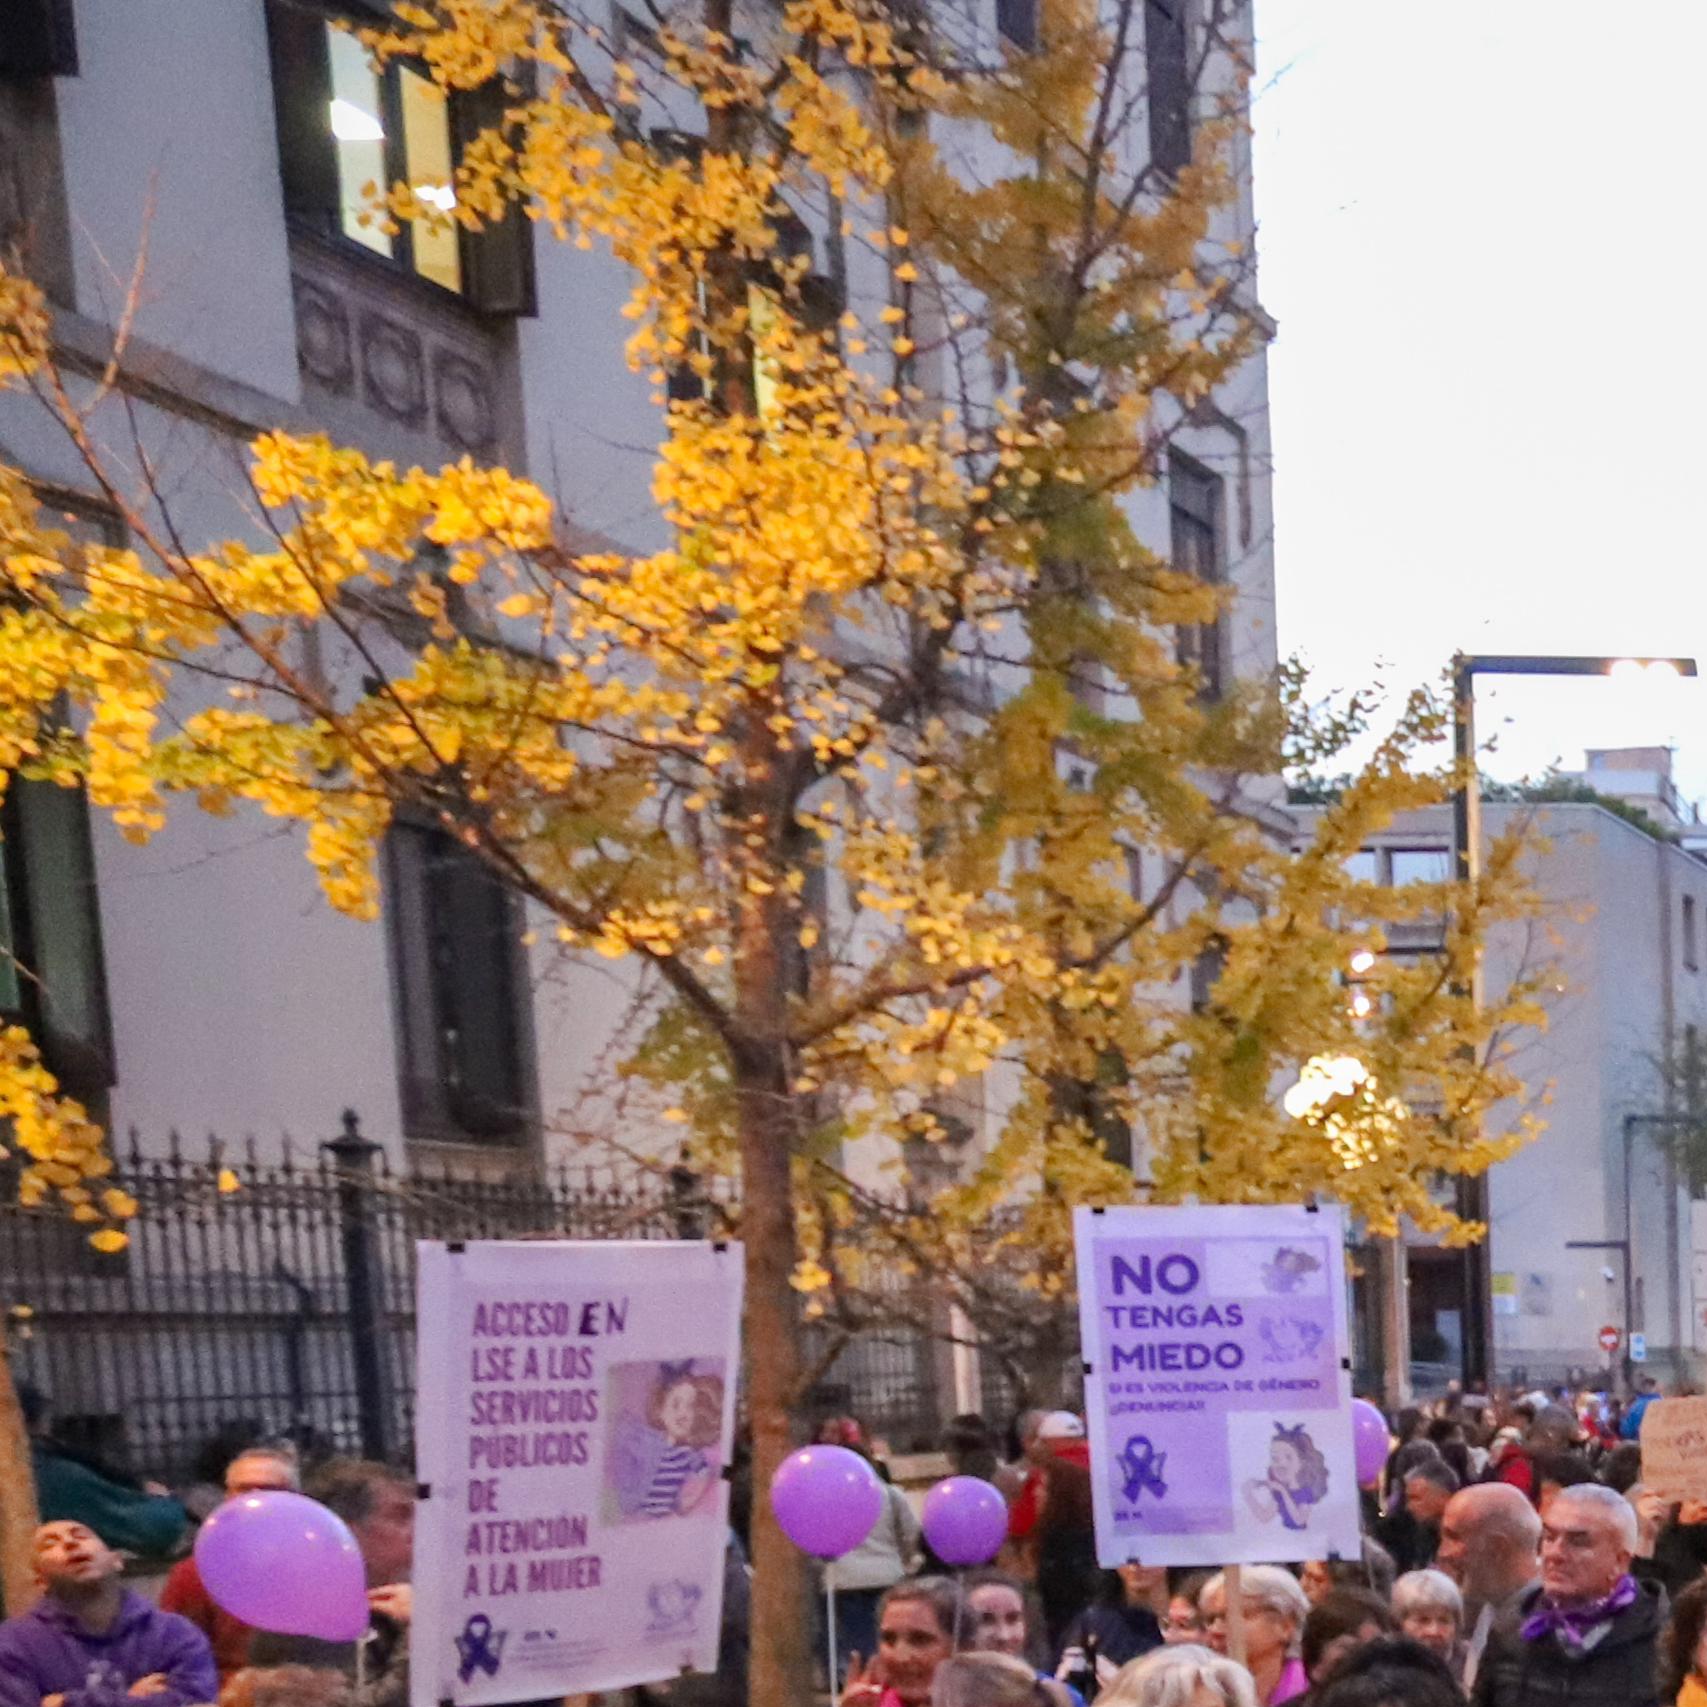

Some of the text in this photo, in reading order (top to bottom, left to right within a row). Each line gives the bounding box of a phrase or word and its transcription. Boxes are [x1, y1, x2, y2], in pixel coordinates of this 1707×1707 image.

[1110, 1253, 1200, 1295] NO
[471, 1296, 630, 1337] ACCESO EN
[1105, 1303, 1244, 1328] TENGAS
[471, 1345, 594, 1382] LSE A LOS
[1111, 1341, 1245, 1372] MIEDO
[470, 1389, 599, 1425] SERVICIOS
[468, 1478, 500, 1514] DE
[463, 1555, 602, 1598] A LA MUJER
